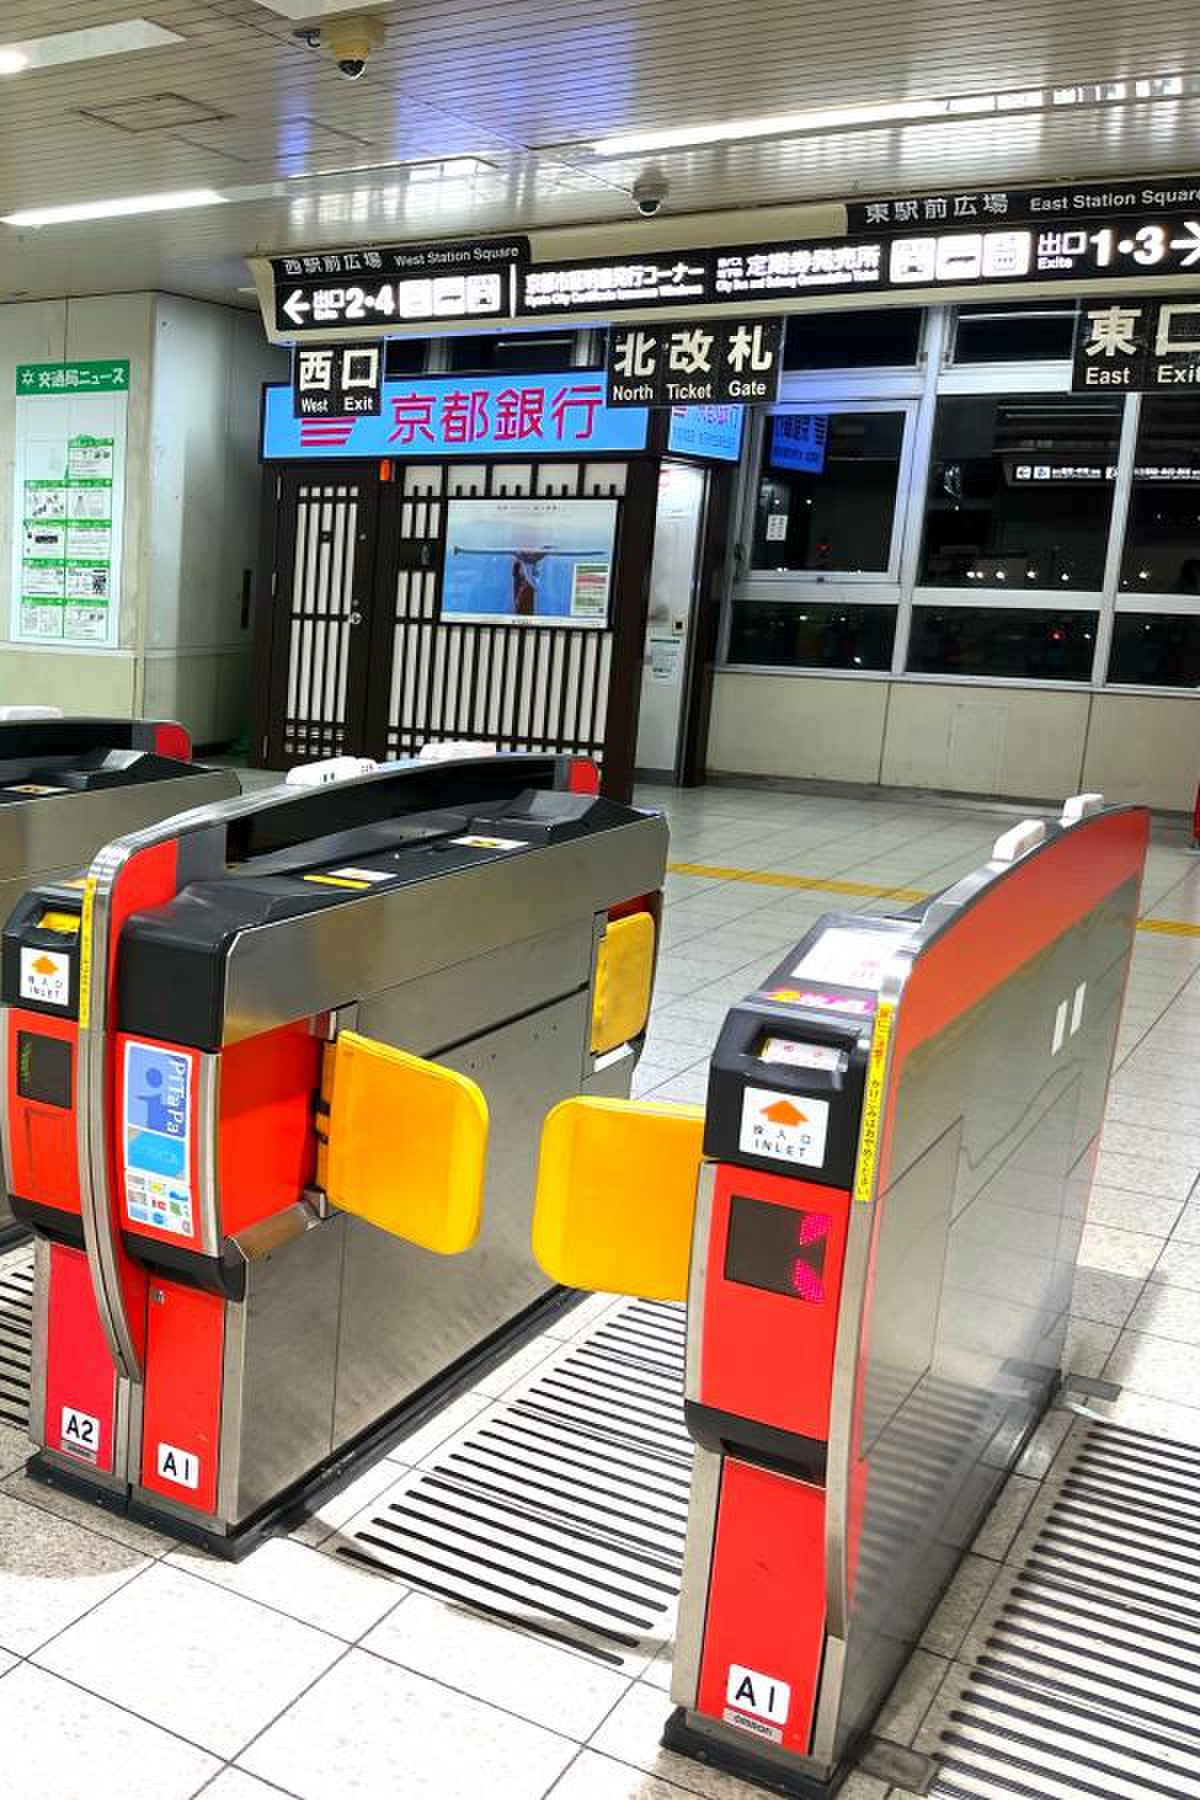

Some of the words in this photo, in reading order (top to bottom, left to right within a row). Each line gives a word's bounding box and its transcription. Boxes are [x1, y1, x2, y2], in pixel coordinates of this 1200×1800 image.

[865, 193, 1008, 223] 東駅前広場
[1030, 197, 1067, 212] East
[1073, 192, 1135, 210] Station
[394, 254, 424, 267] West
[428, 251, 471, 264] Station
[473, 247, 519, 261] Square
[1037, 231, 1087, 257] 出口
[284, 252, 382, 275] 西駅前広場
[1085, 304, 1200, 357] 東口
[613, 326, 774, 379] 北改札
[299, 348, 379, 392] 西口
[1085, 367, 1131, 385] East
[301, 398, 329, 413] West
[343, 394, 373, 412] Exit
[612, 385, 653, 400] North
[666, 383, 712, 400] Ticket
[728, 380, 766, 397] Gate
[388, 385, 602, 444] 京都銀行
[755, 1138, 806, 1157] INLET
[66, 1414, 93, 1443] A2
[163, 1451, 189, 1480] A1
[735, 1675, 775, 1713] A1
